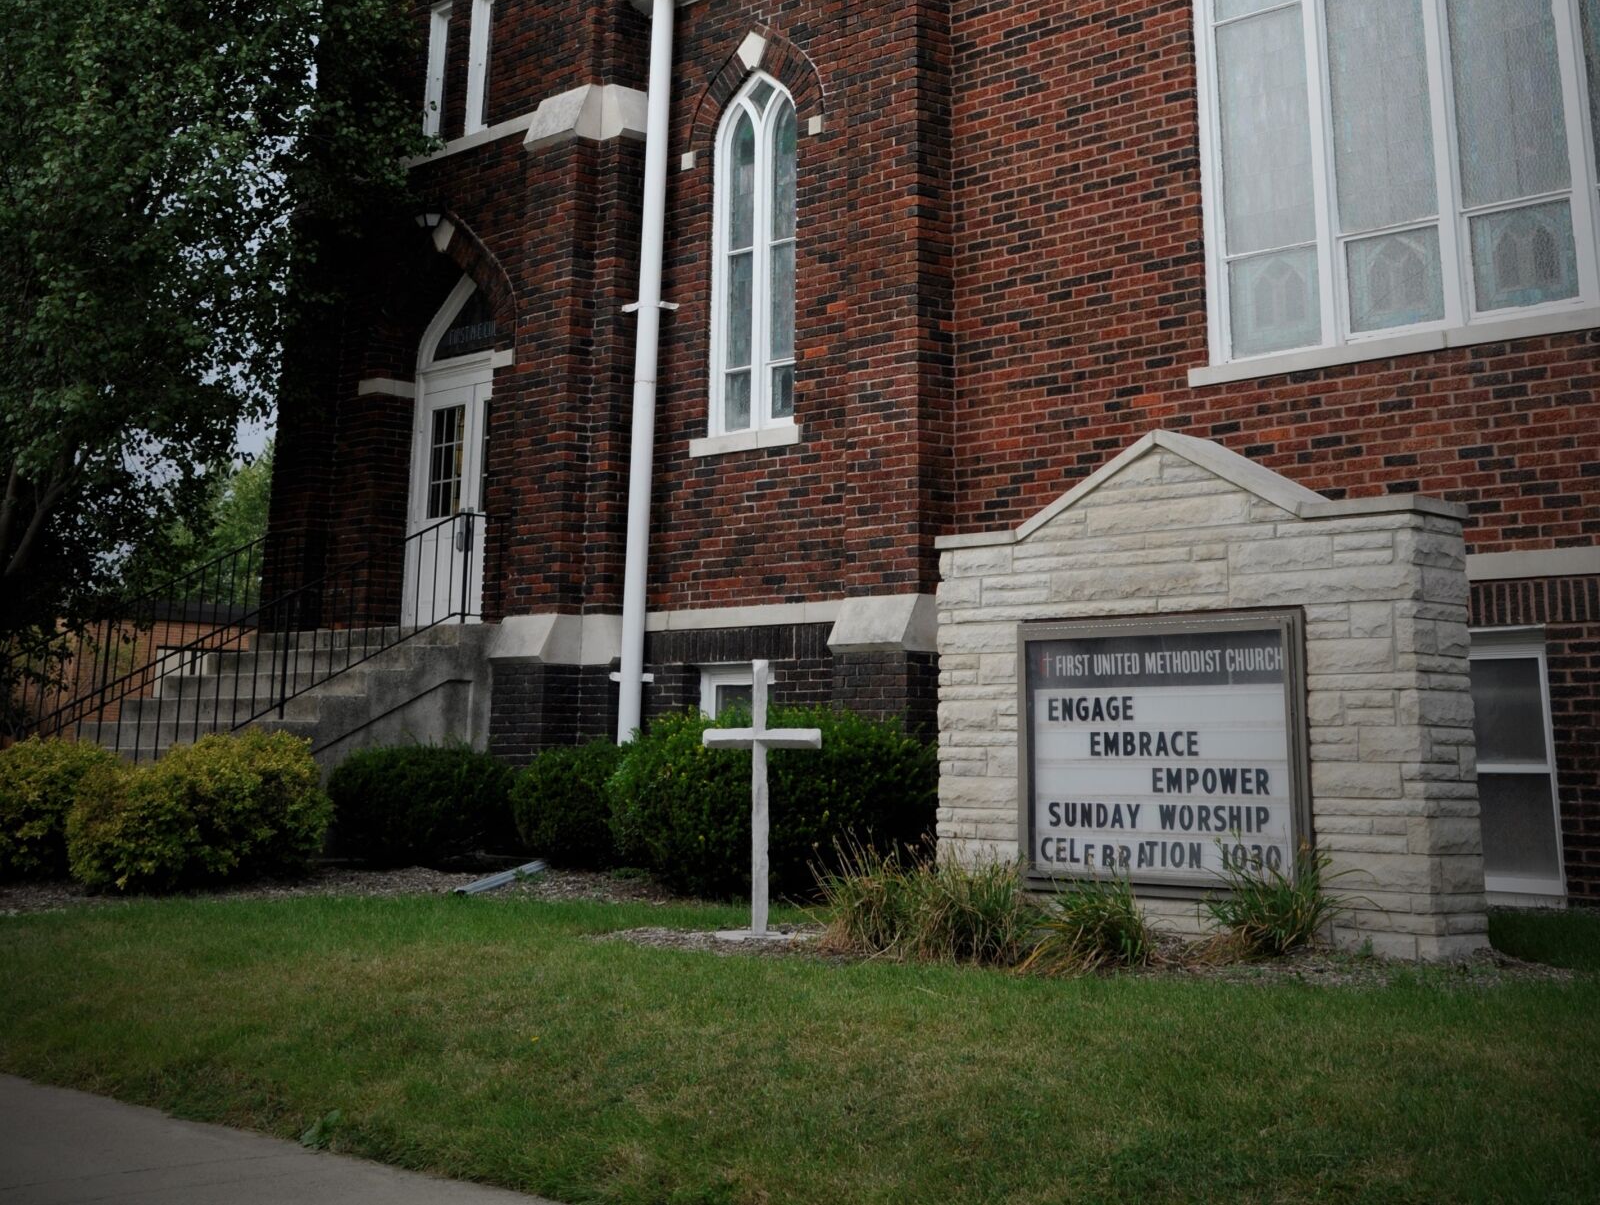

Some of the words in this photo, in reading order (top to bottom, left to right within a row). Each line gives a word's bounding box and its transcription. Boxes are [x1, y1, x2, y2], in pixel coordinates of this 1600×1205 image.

[1056, 654, 1090, 676] FIRST
[1094, 652, 1140, 676] UNITED
[1145, 649, 1222, 674] METHODIST
[1225, 647, 1284, 672] CHURCH
[1048, 696, 1134, 722] ENGAGE
[1090, 731, 1199, 756] EMBRACE
[1152, 767, 1270, 795] EMPOWER
[1048, 802, 1141, 829] SUNDAY
[1159, 804, 1270, 832] WORSHIP
